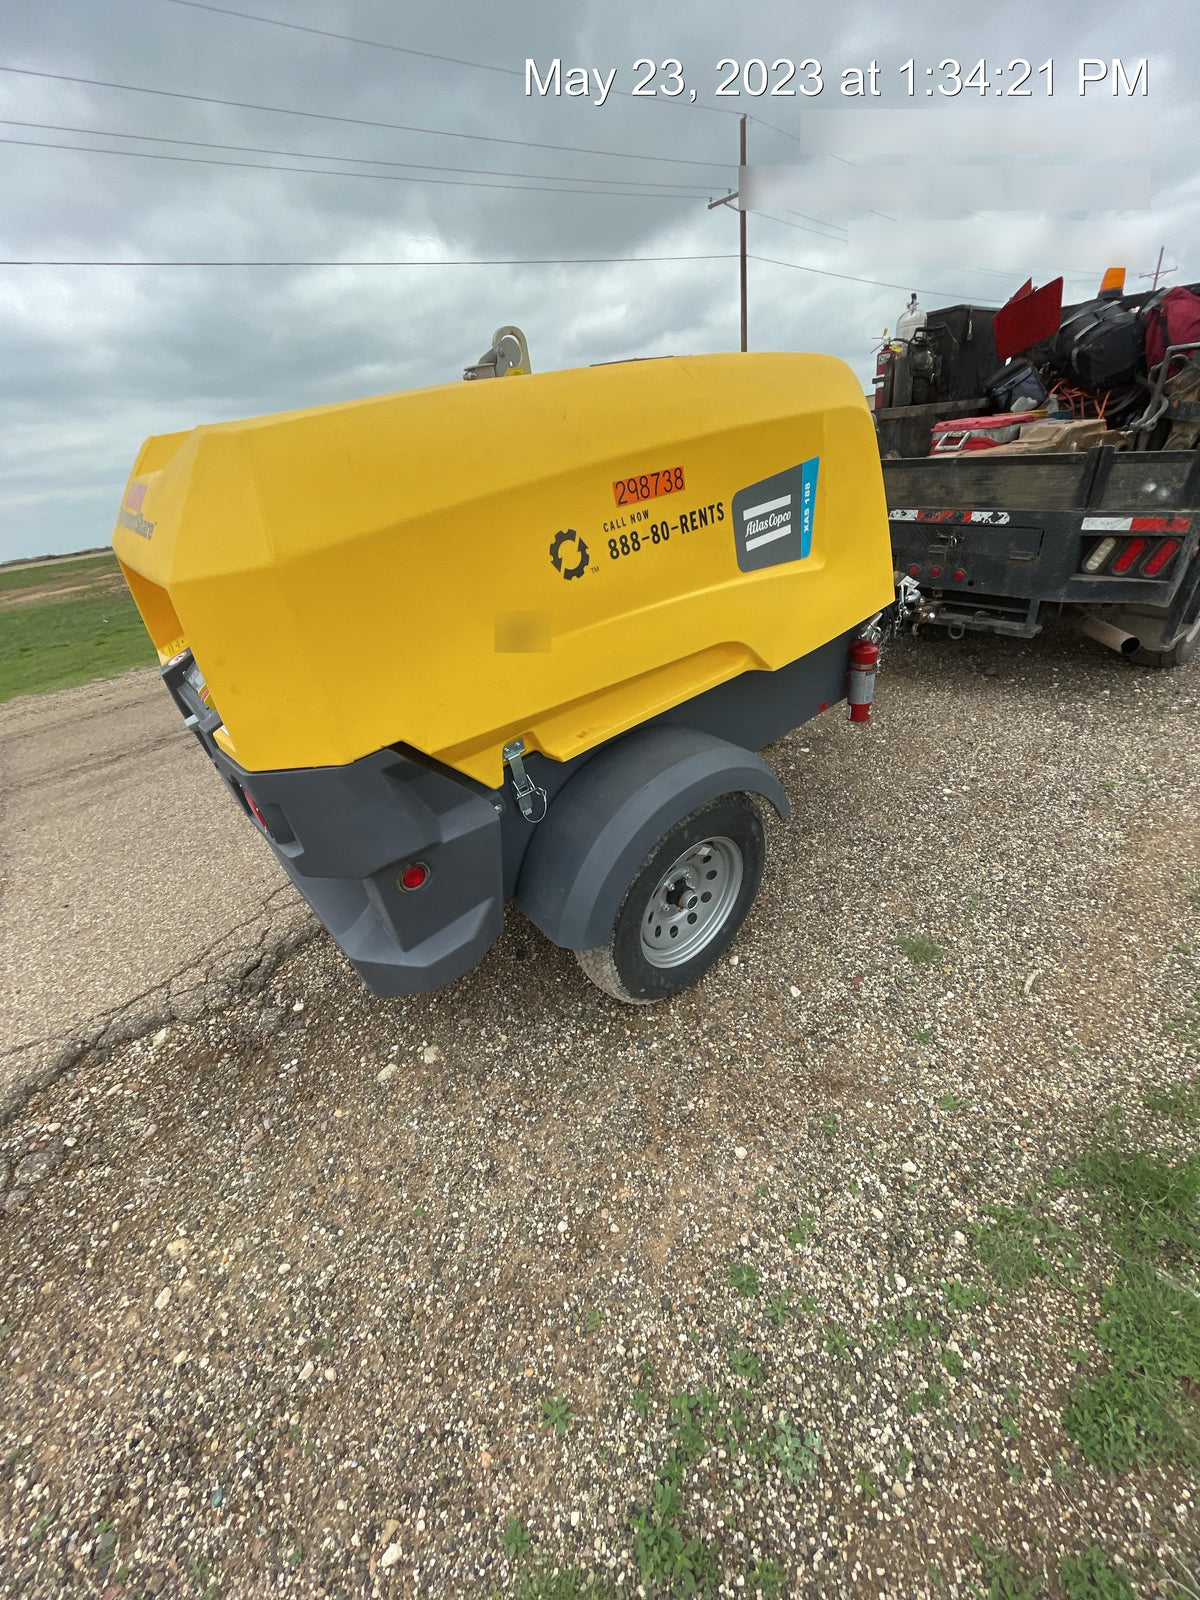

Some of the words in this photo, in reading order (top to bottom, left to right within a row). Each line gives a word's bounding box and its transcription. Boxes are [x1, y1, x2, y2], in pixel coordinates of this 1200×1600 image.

[615, 467, 684, 506] 298738
[602, 516, 627, 533] CALL
[630, 509, 649, 524] NOW
[607, 502, 725, 560] 888-80-RENTS
